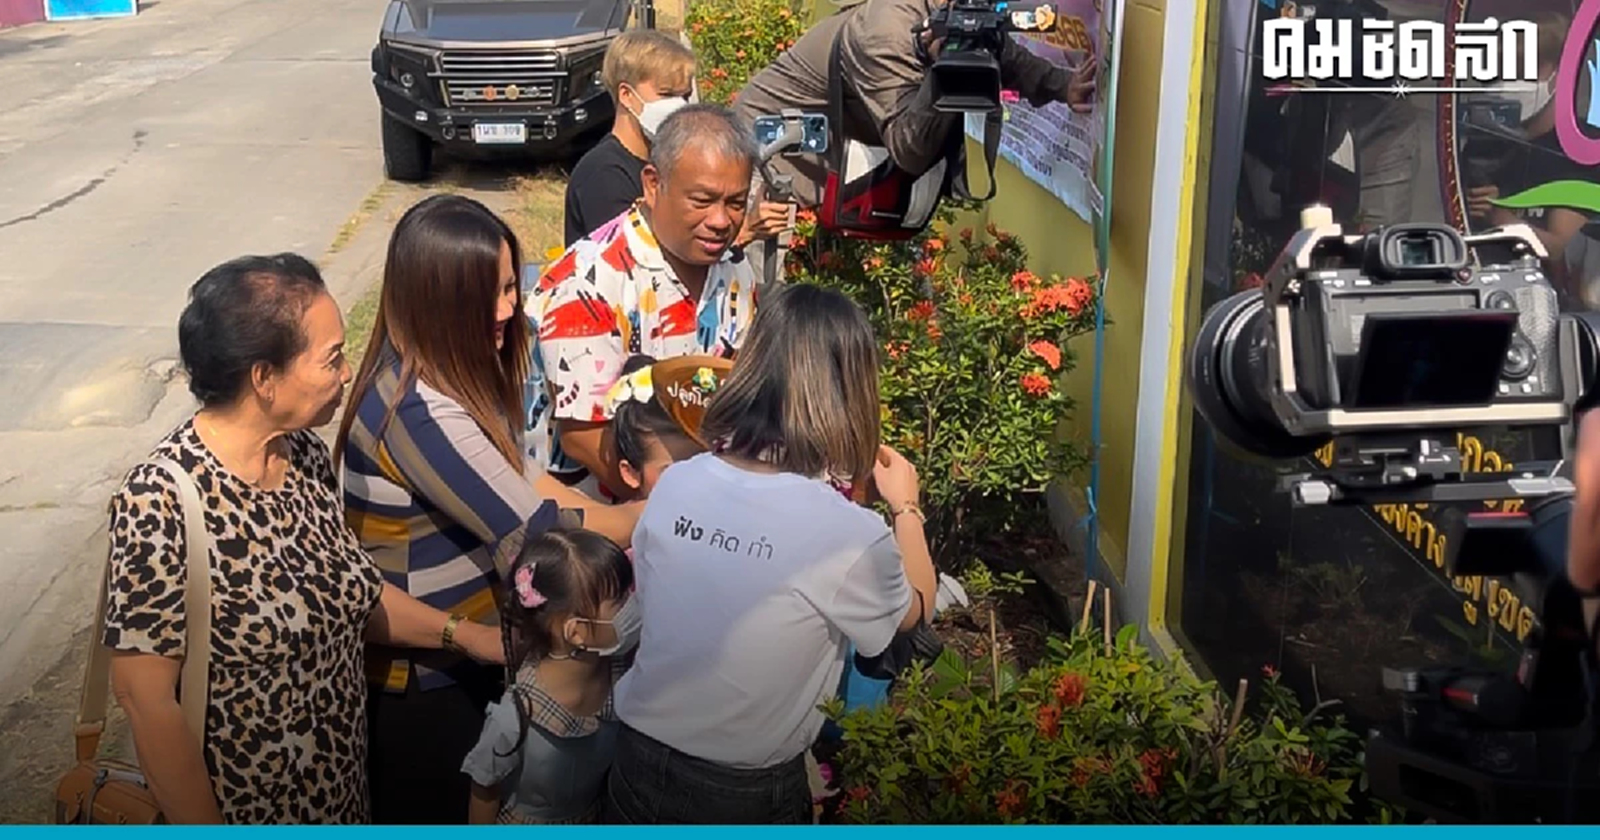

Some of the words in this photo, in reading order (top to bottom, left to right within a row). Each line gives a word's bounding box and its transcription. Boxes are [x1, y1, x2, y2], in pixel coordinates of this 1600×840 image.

[674, 515, 704, 541] ฟัง
[709, 528, 740, 552] คิด
[747, 535, 774, 560] ทำ
